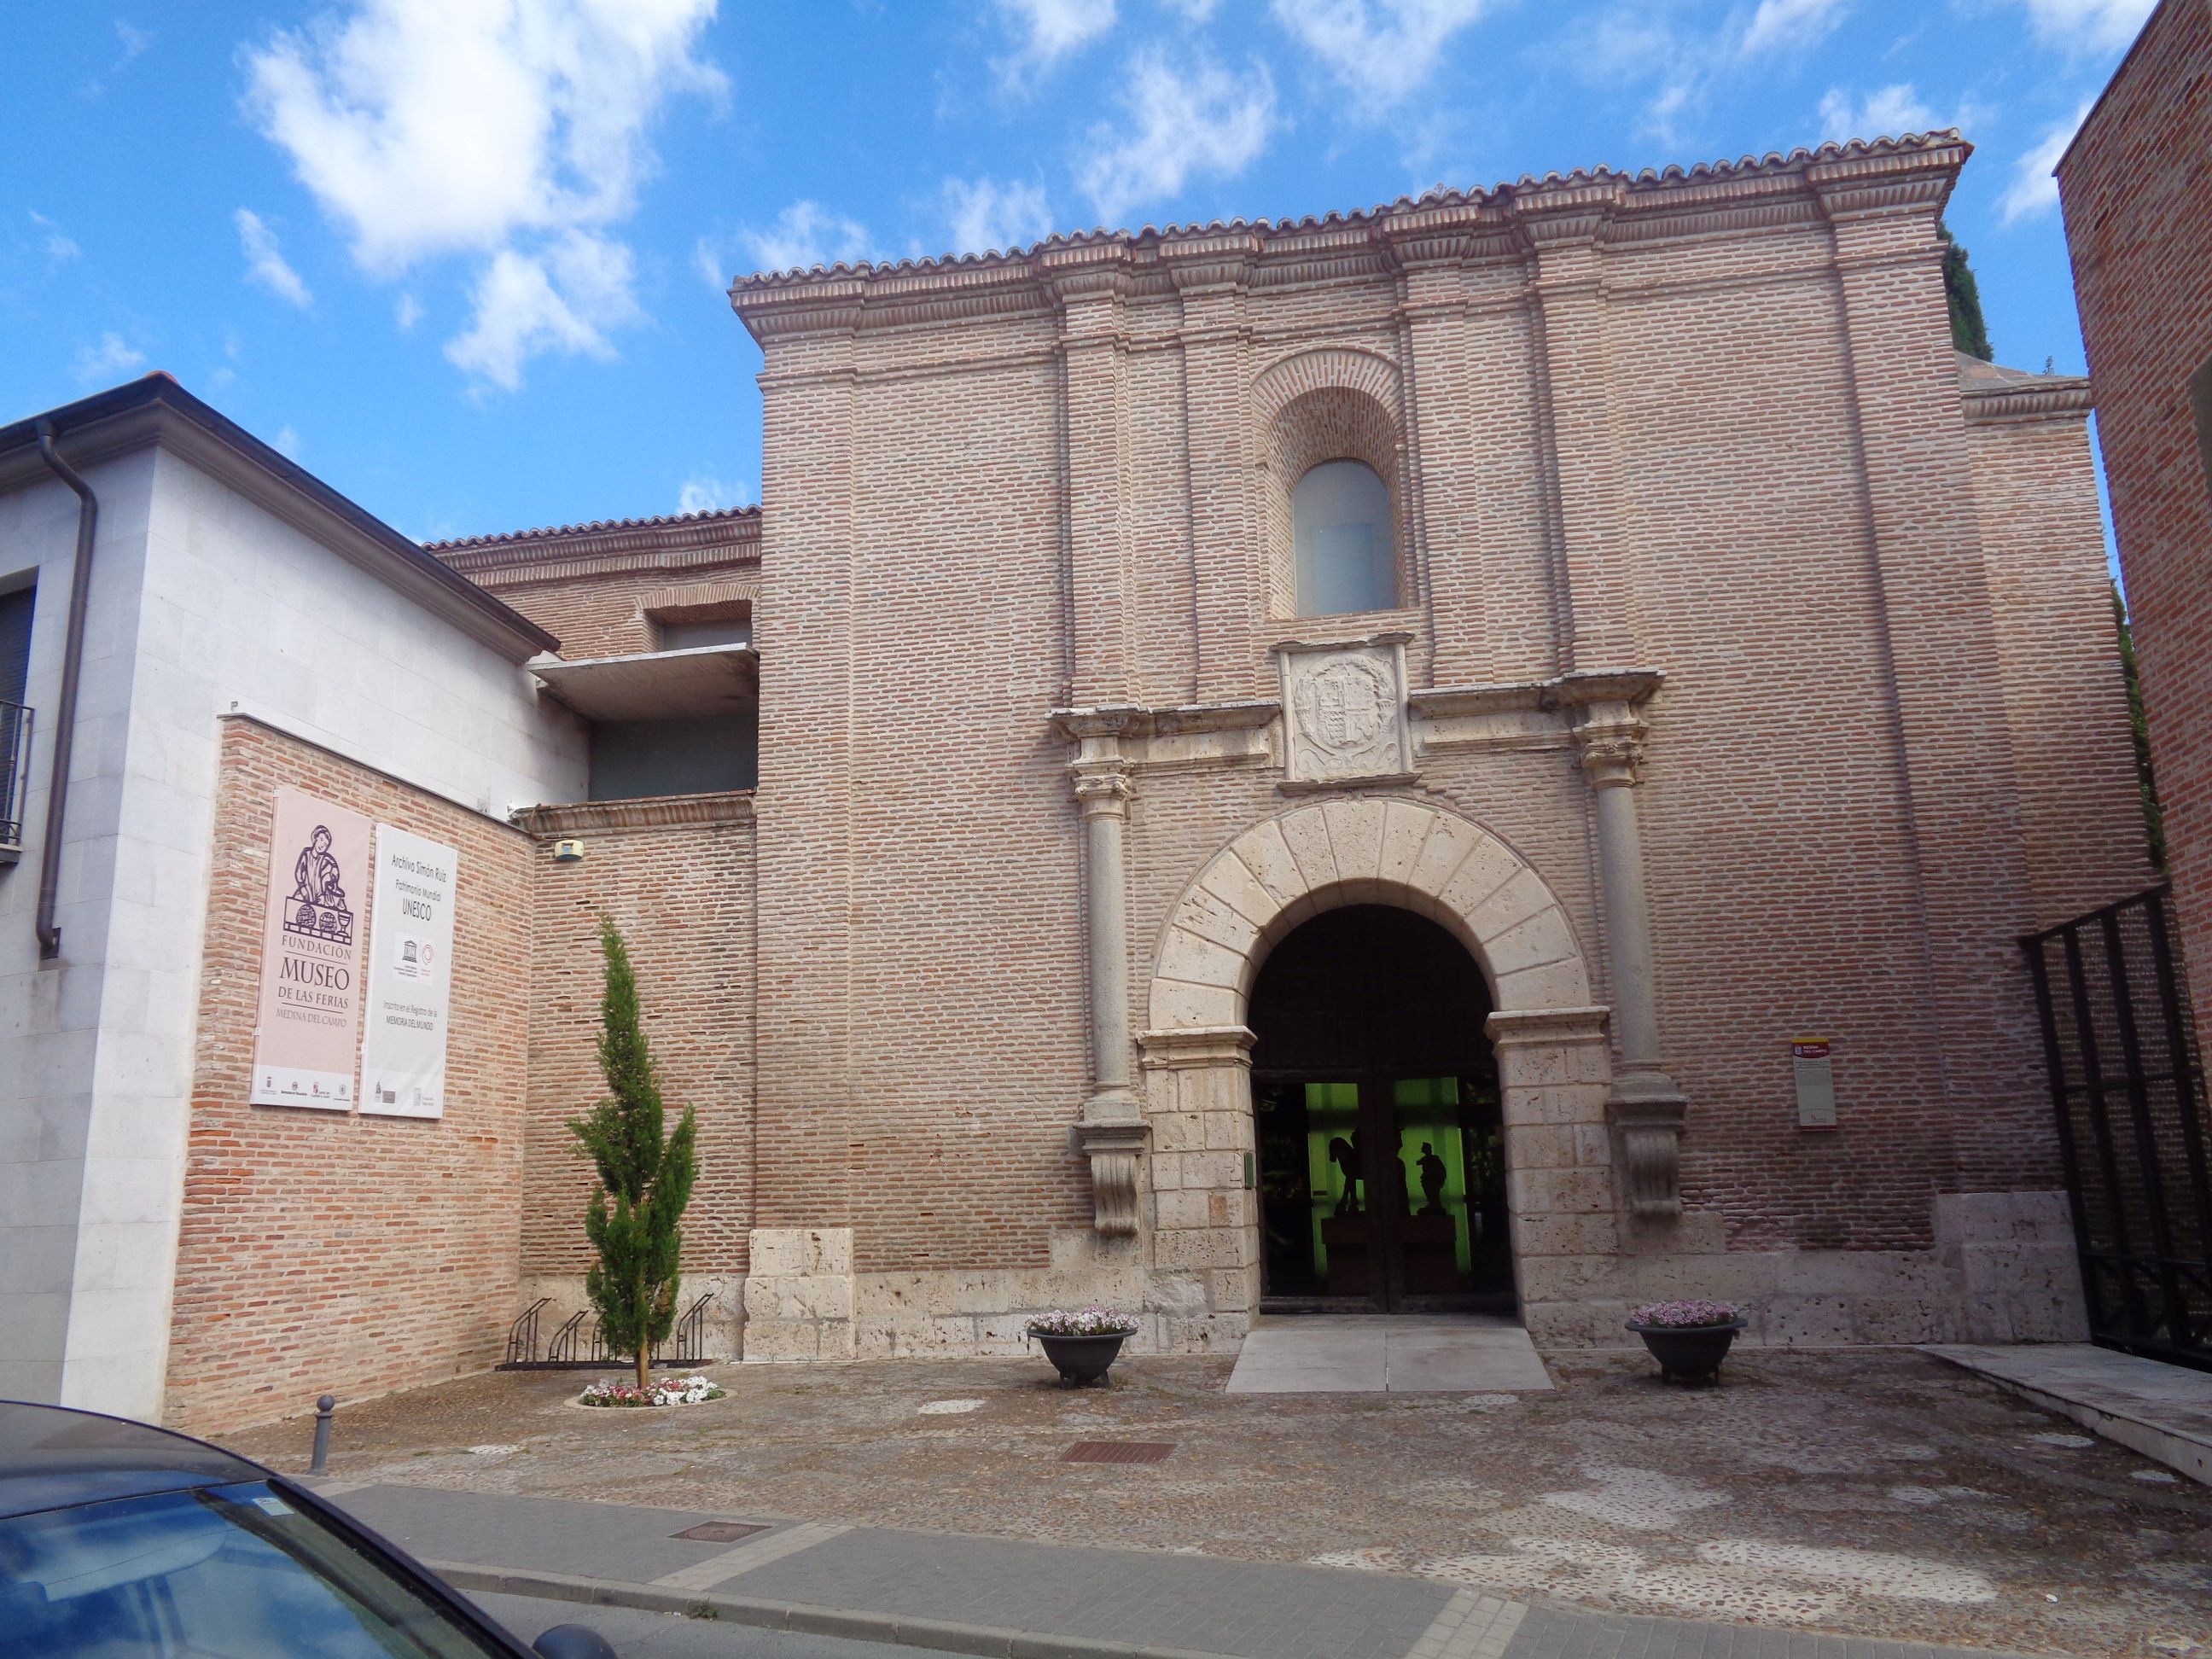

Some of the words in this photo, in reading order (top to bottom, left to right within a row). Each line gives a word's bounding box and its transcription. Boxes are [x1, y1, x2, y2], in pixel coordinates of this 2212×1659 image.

[392, 854, 415, 872] Archivo
[416, 861, 434, 879] Simón
[435, 867, 447, 882] Ruiz
[396, 879, 422, 896] Patrimonio
[422, 888, 440, 901] Mundial
[402, 898, 432, 922] UNESCO
[282, 934, 352, 960] FUNDACIÓN
[279, 957, 349, 990] MUSEO
[278, 986, 293, 999] DE
[295, 989, 313, 1003] LAS
[316, 993, 348, 1009] FERIAS
[276, 1009, 306, 1022] MEDINA
[307, 1013, 321, 1024] DEL
[322, 1016, 347, 1027] CAMPO
[386, 1015, 407, 1027] MEMORIA
[407, 1019, 416, 1027] DEL
[416, 1020, 434, 1031] MUNDO
